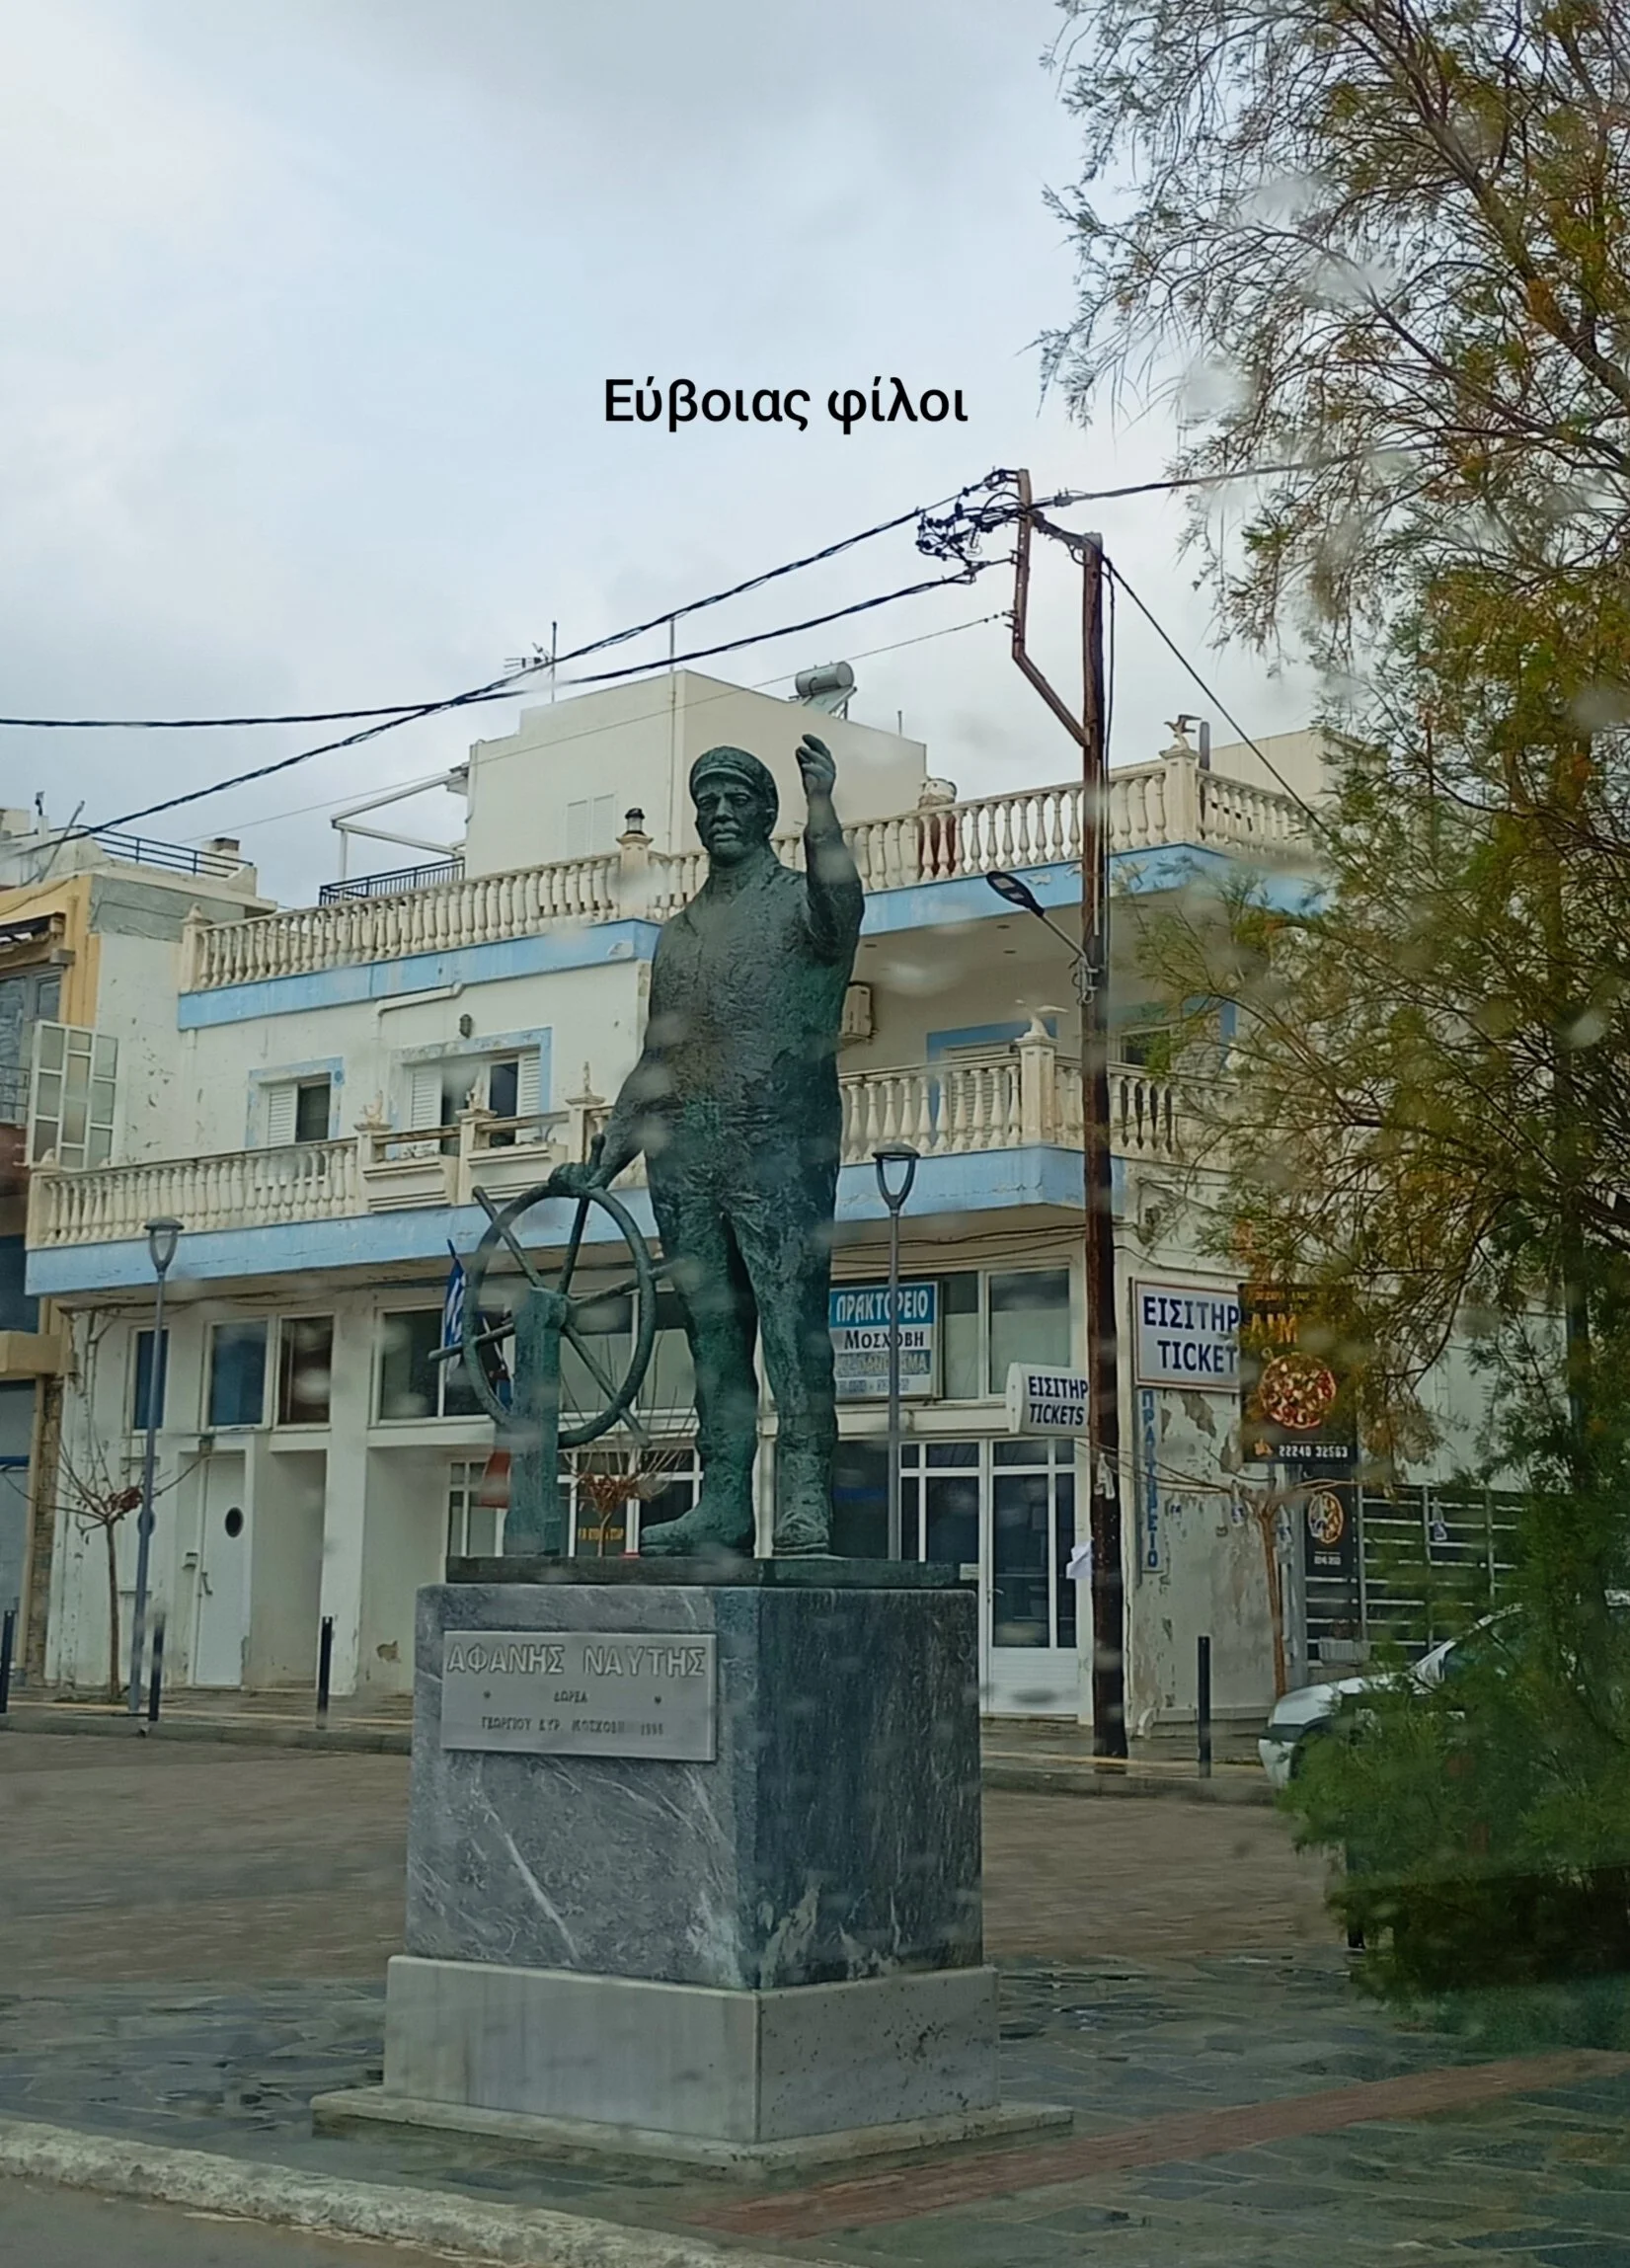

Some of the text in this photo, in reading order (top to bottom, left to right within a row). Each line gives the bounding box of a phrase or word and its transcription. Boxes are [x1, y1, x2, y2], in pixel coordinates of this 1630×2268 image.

[1030, 1403, 1085, 1426] TICKETS
[447, 1643, 707, 1678] ΑΦΑΝΗΣ ΝΑΥΤΗΣ
